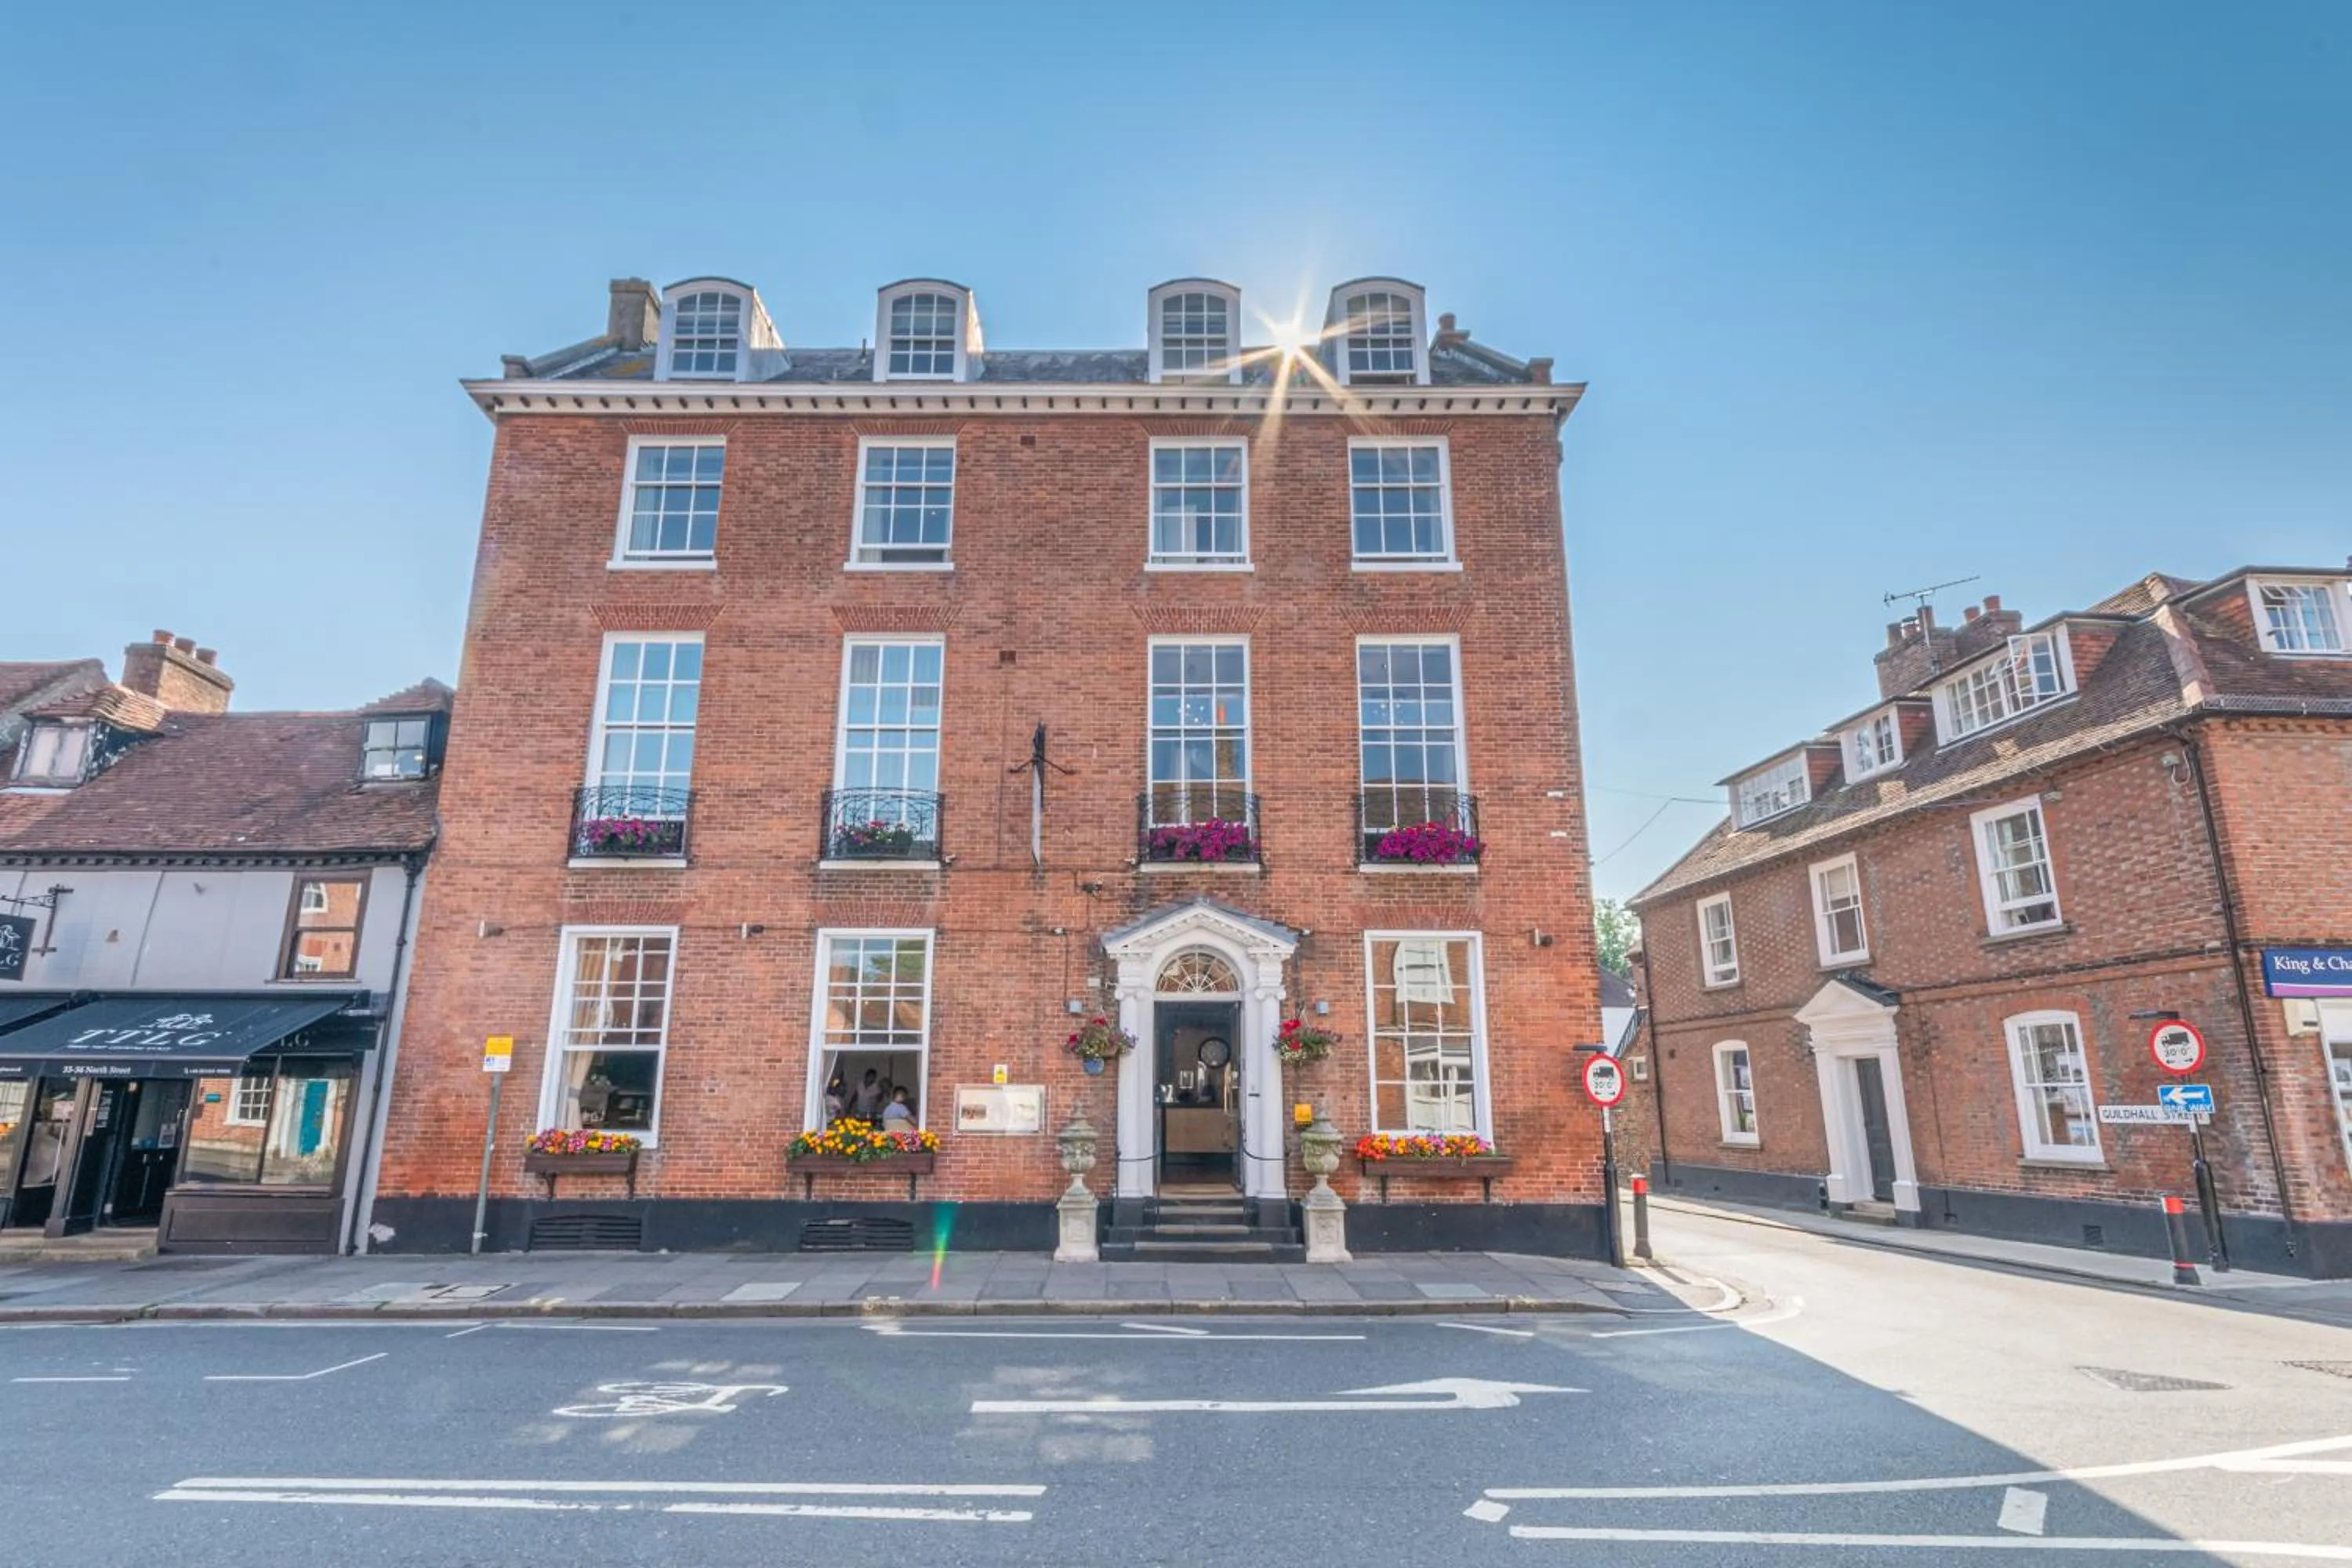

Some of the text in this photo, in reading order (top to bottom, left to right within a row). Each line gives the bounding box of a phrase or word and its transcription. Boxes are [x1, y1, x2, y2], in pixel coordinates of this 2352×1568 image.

[2274, 955, 2352, 974] King & Cha
[67, 1029, 223, 1046] TTLG
[2103, 1109, 2205, 1120] GUILDHALL STRET
